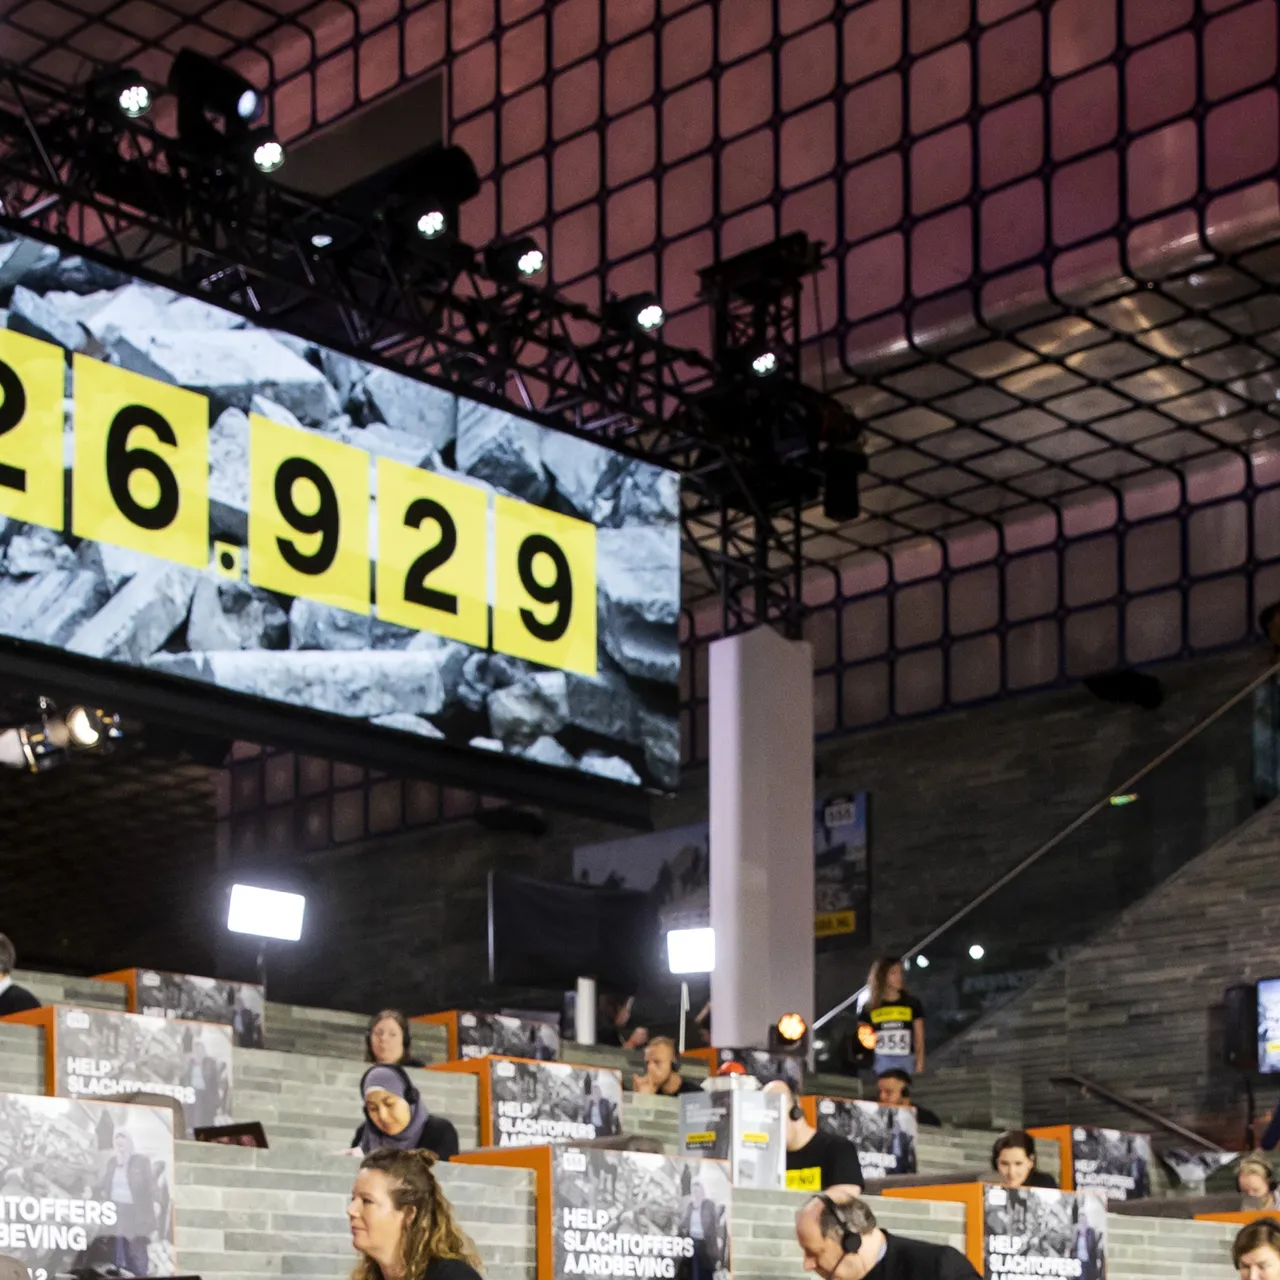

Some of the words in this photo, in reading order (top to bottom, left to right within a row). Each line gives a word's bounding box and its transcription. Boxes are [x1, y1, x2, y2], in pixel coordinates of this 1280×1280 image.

[67, 1056, 112, 1076] HELP
[497, 1101, 531, 1118] HELP
[498, 1117, 597, 1140] SLACHTOFFERS
[563, 1207, 609, 1229] HELP
[563, 1230, 695, 1258] SLACHTOFFERS
[563, 1253, 676, 1278] AARDBEVING
